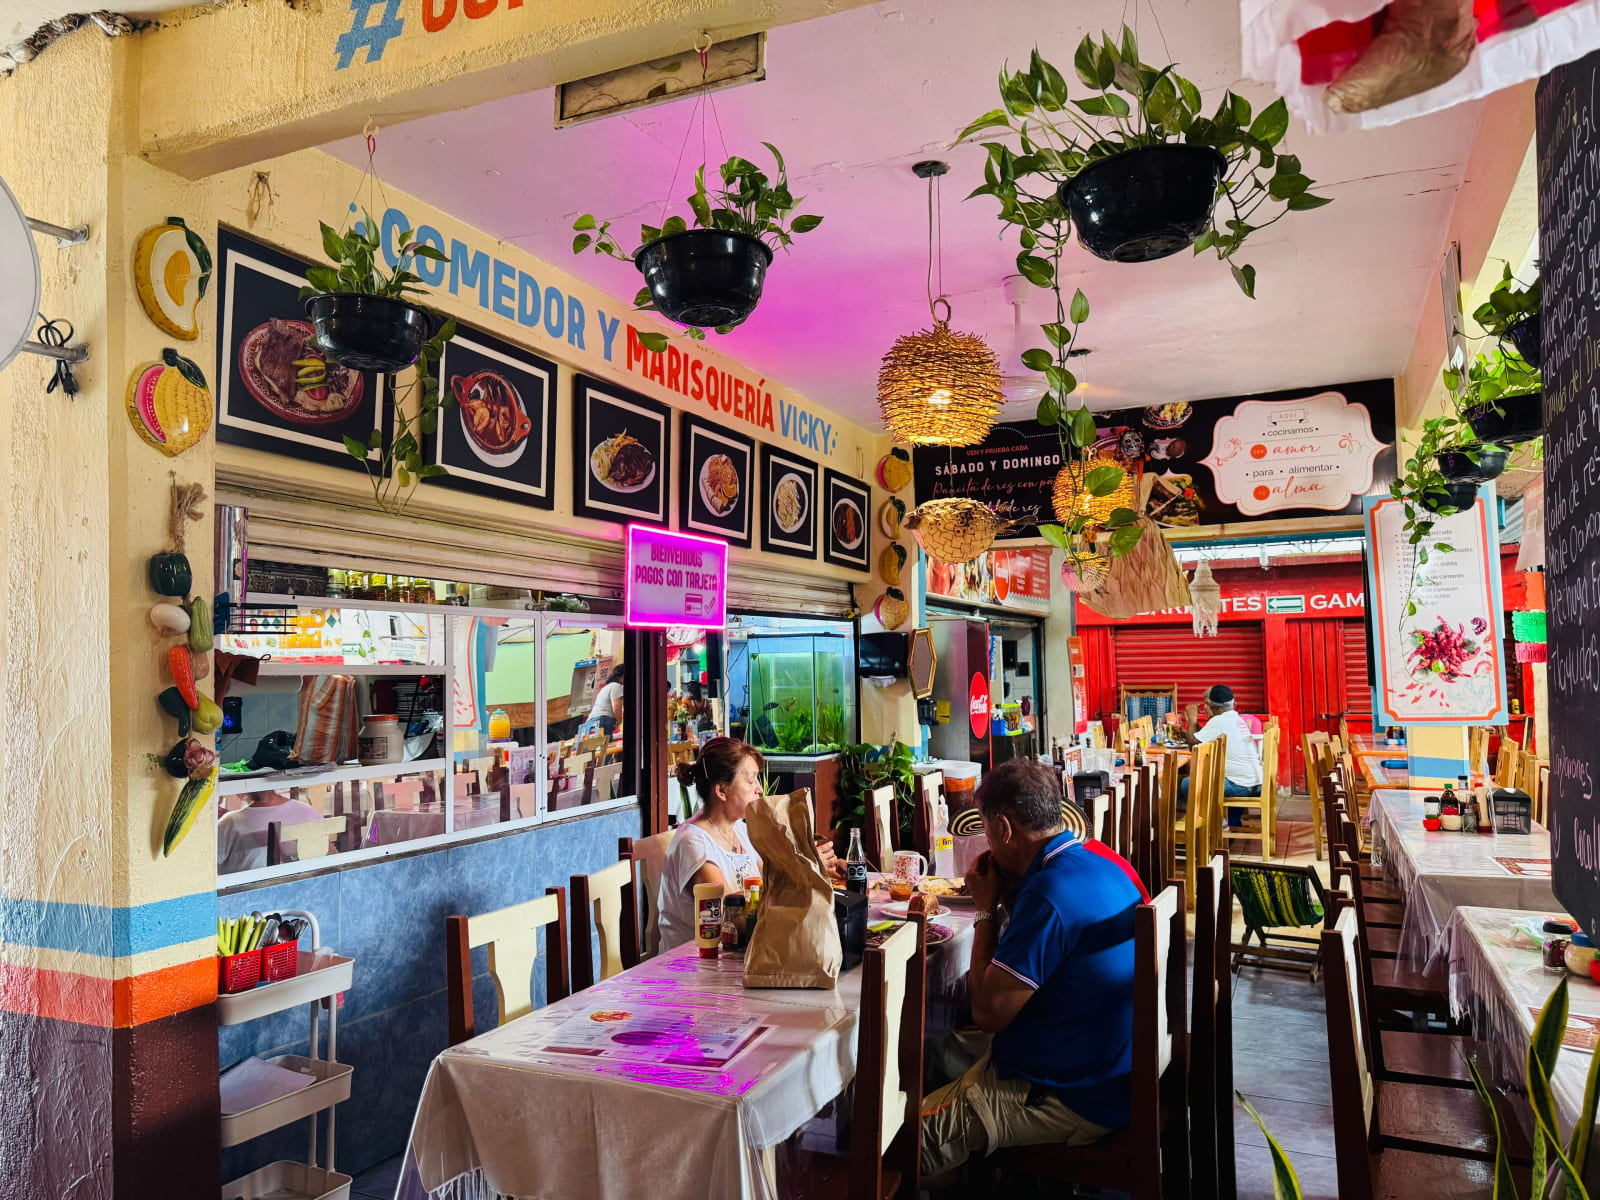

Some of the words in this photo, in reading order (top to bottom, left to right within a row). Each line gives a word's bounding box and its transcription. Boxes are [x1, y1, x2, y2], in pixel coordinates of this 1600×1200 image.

[1589, 240, 1600, 296] gu
[381, 207, 586, 351] COMEDOR
[597, 309, 621, 363] Y
[626, 322, 775, 433] MARISQUERÍA
[1267, 426, 1314, 437] cocinamos
[966, 449, 980, 457] VEN
[985, 447, 1010, 455] PRUEBA
[1011, 444, 1029, 453] CADA
[1272, 444, 1321, 455] amor
[935, 462, 984, 476] SÁBADO
[990, 460, 997, 471] Y
[1003, 454, 1061, 470] DOMINGO
[1252, 469, 1274, 480] para
[1288, 463, 1334, 475] alimentar
[1272, 476, 1326, 499] alma
[650, 543, 703, 568] BIENVENIDOS
[635, 564, 665, 587] PAGOS
[666, 568, 683, 588] CON
[685, 570, 718, 592] TARJETA
